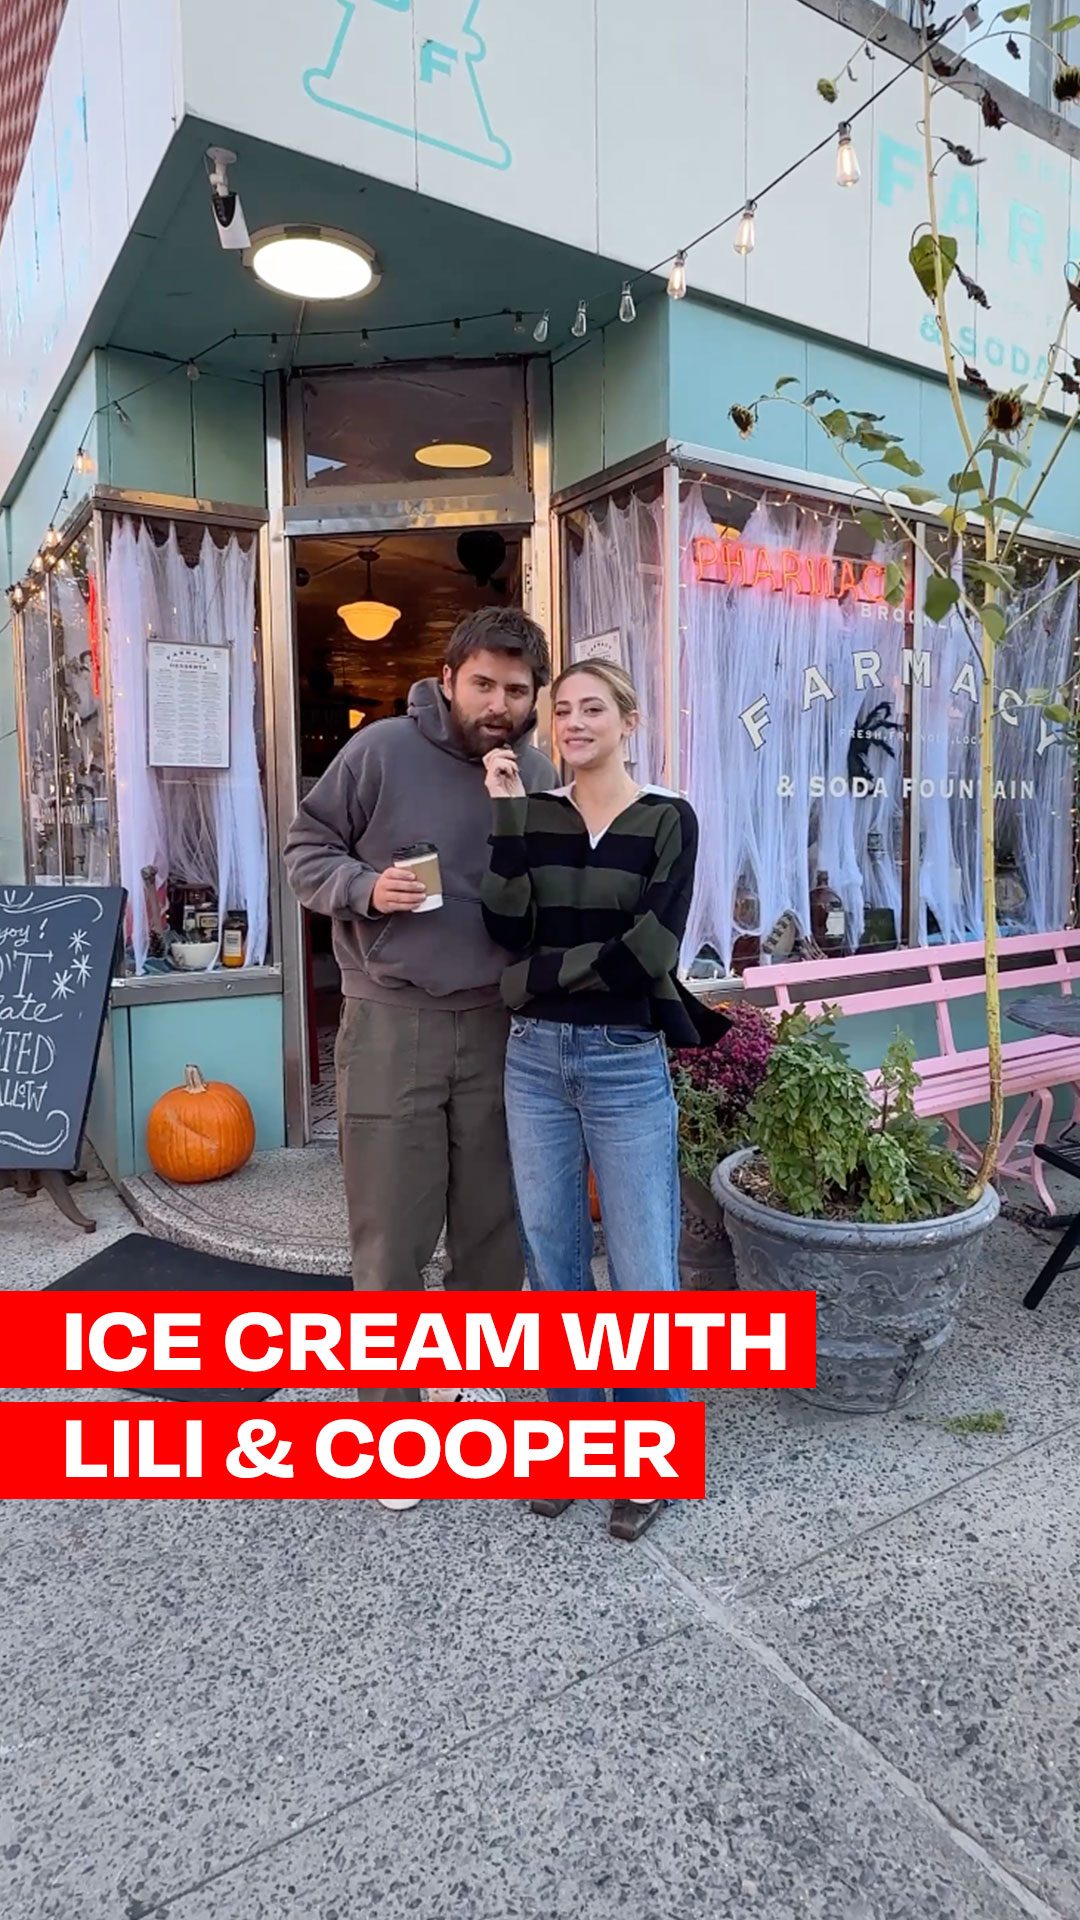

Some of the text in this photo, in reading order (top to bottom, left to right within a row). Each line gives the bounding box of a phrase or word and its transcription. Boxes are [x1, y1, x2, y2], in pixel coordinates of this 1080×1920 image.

[421, 40, 457, 83] F
[878, 131, 1080, 282] FAR
[692, 536, 886, 602] PHARMAC
[776, 774, 1034, 800] & SODA FOUNAIN
